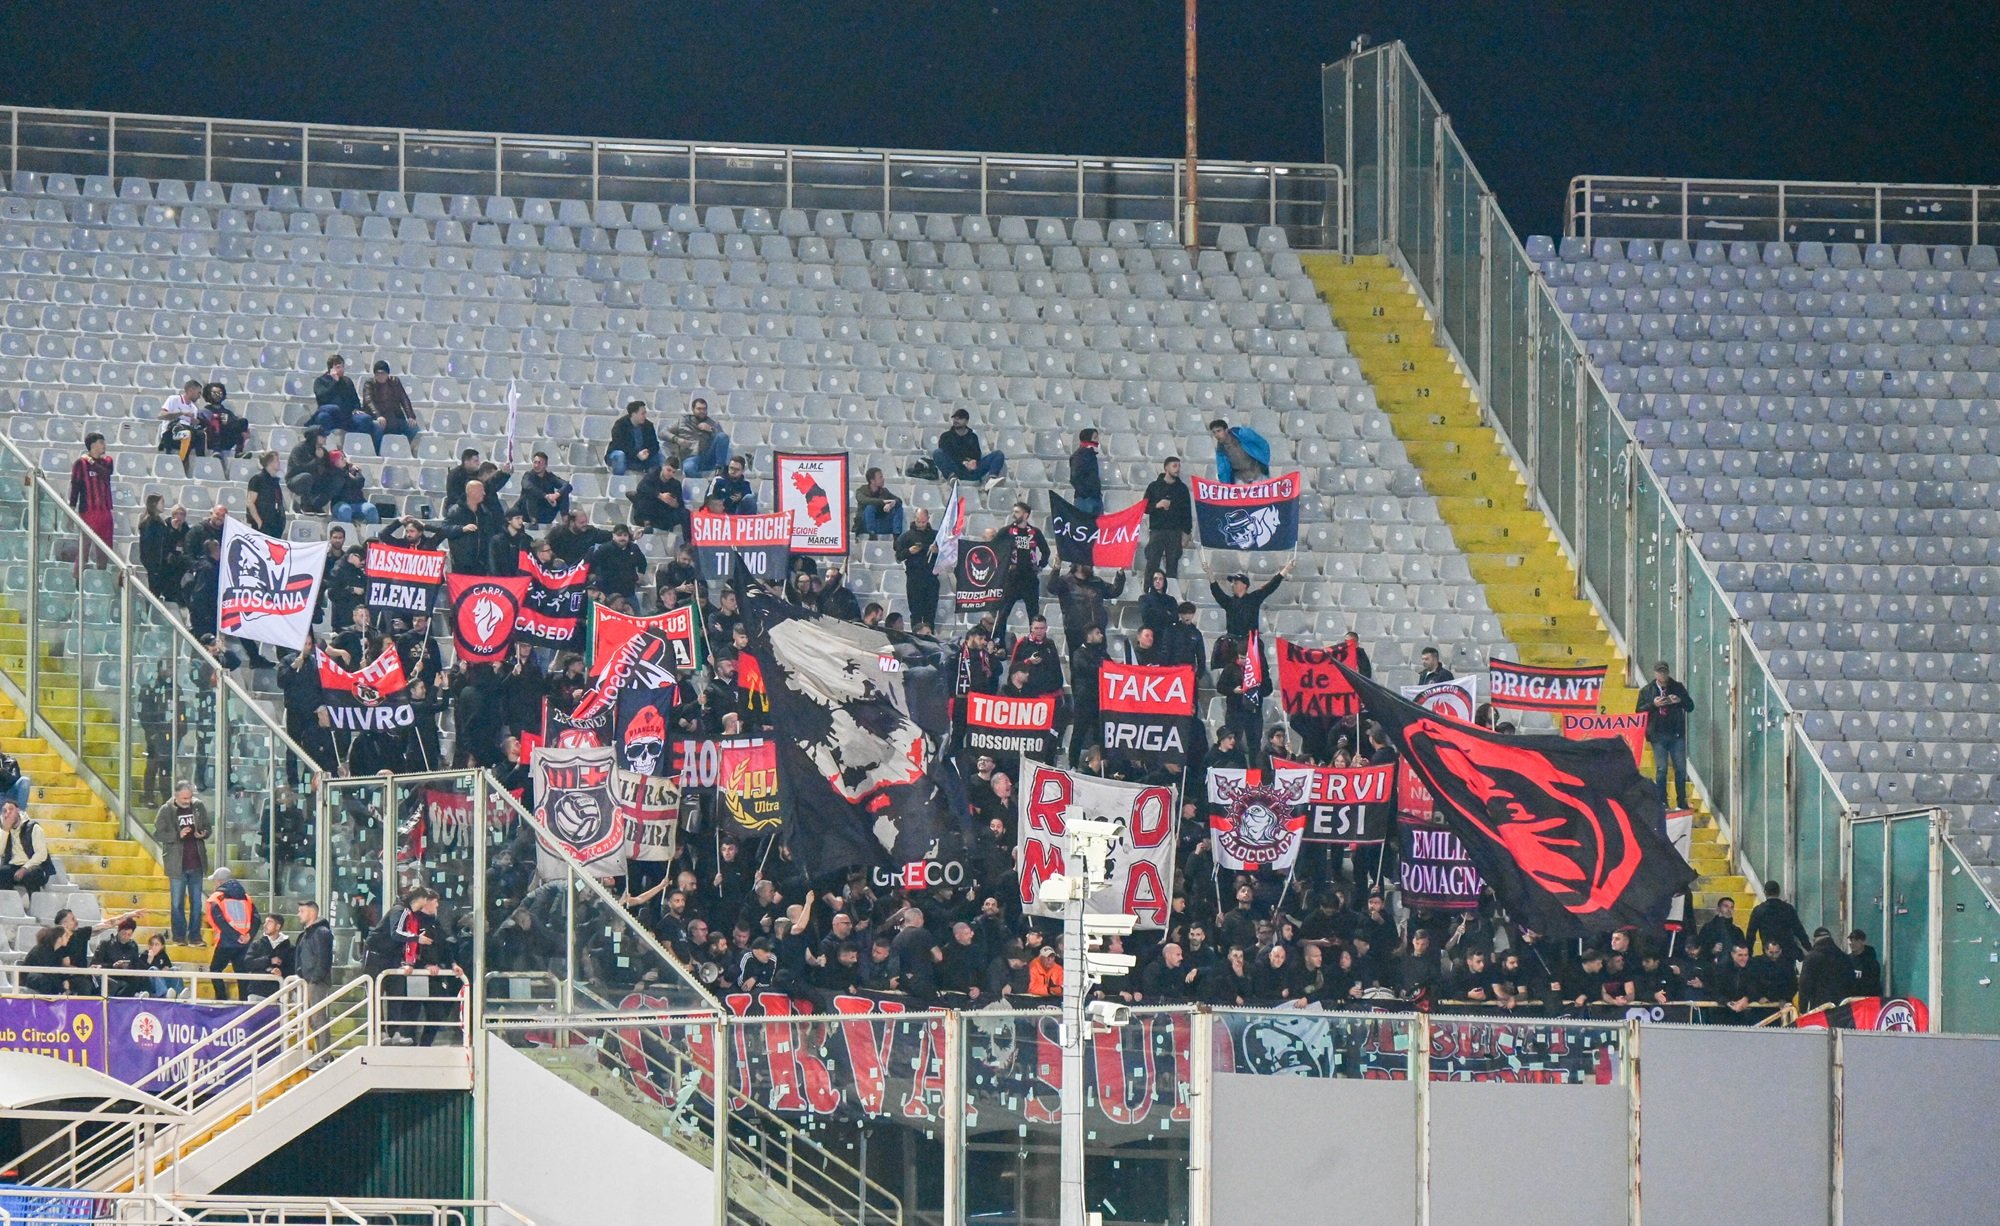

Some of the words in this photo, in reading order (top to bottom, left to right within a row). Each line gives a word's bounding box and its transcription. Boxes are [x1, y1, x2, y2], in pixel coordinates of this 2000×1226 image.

[693, 514, 731, 541] SARÀ
[793, 527, 818, 535] EGIONE
[808, 536, 839, 545] MARCHE
[715, 552, 729, 575] TI
[739, 551, 767, 575] MO
[232, 589, 306, 611] TOSCANA
[369, 583, 427, 612] ELENA
[473, 587, 503, 597] CARPI
[1104, 672, 1187, 704] TAKA
[1300, 668, 1329, 689] de
[973, 698, 1048, 726] TICINO
[1565, 714, 1646, 730] DOMANI
[971, 732, 1044, 752] ROSSONERO
[1104, 721, 1184, 754] BRIGA
[619, 778, 679, 806] LTRAS
[1310, 772, 1387, 800] ERVI
[1308, 805, 1366, 836] ESI
[873, 861, 964, 887] GRECO
[21, 1028, 71, 1043] Circolo
[167, 1023, 208, 1046] VIOLA
[212, 1027, 248, 1047] CLUB
